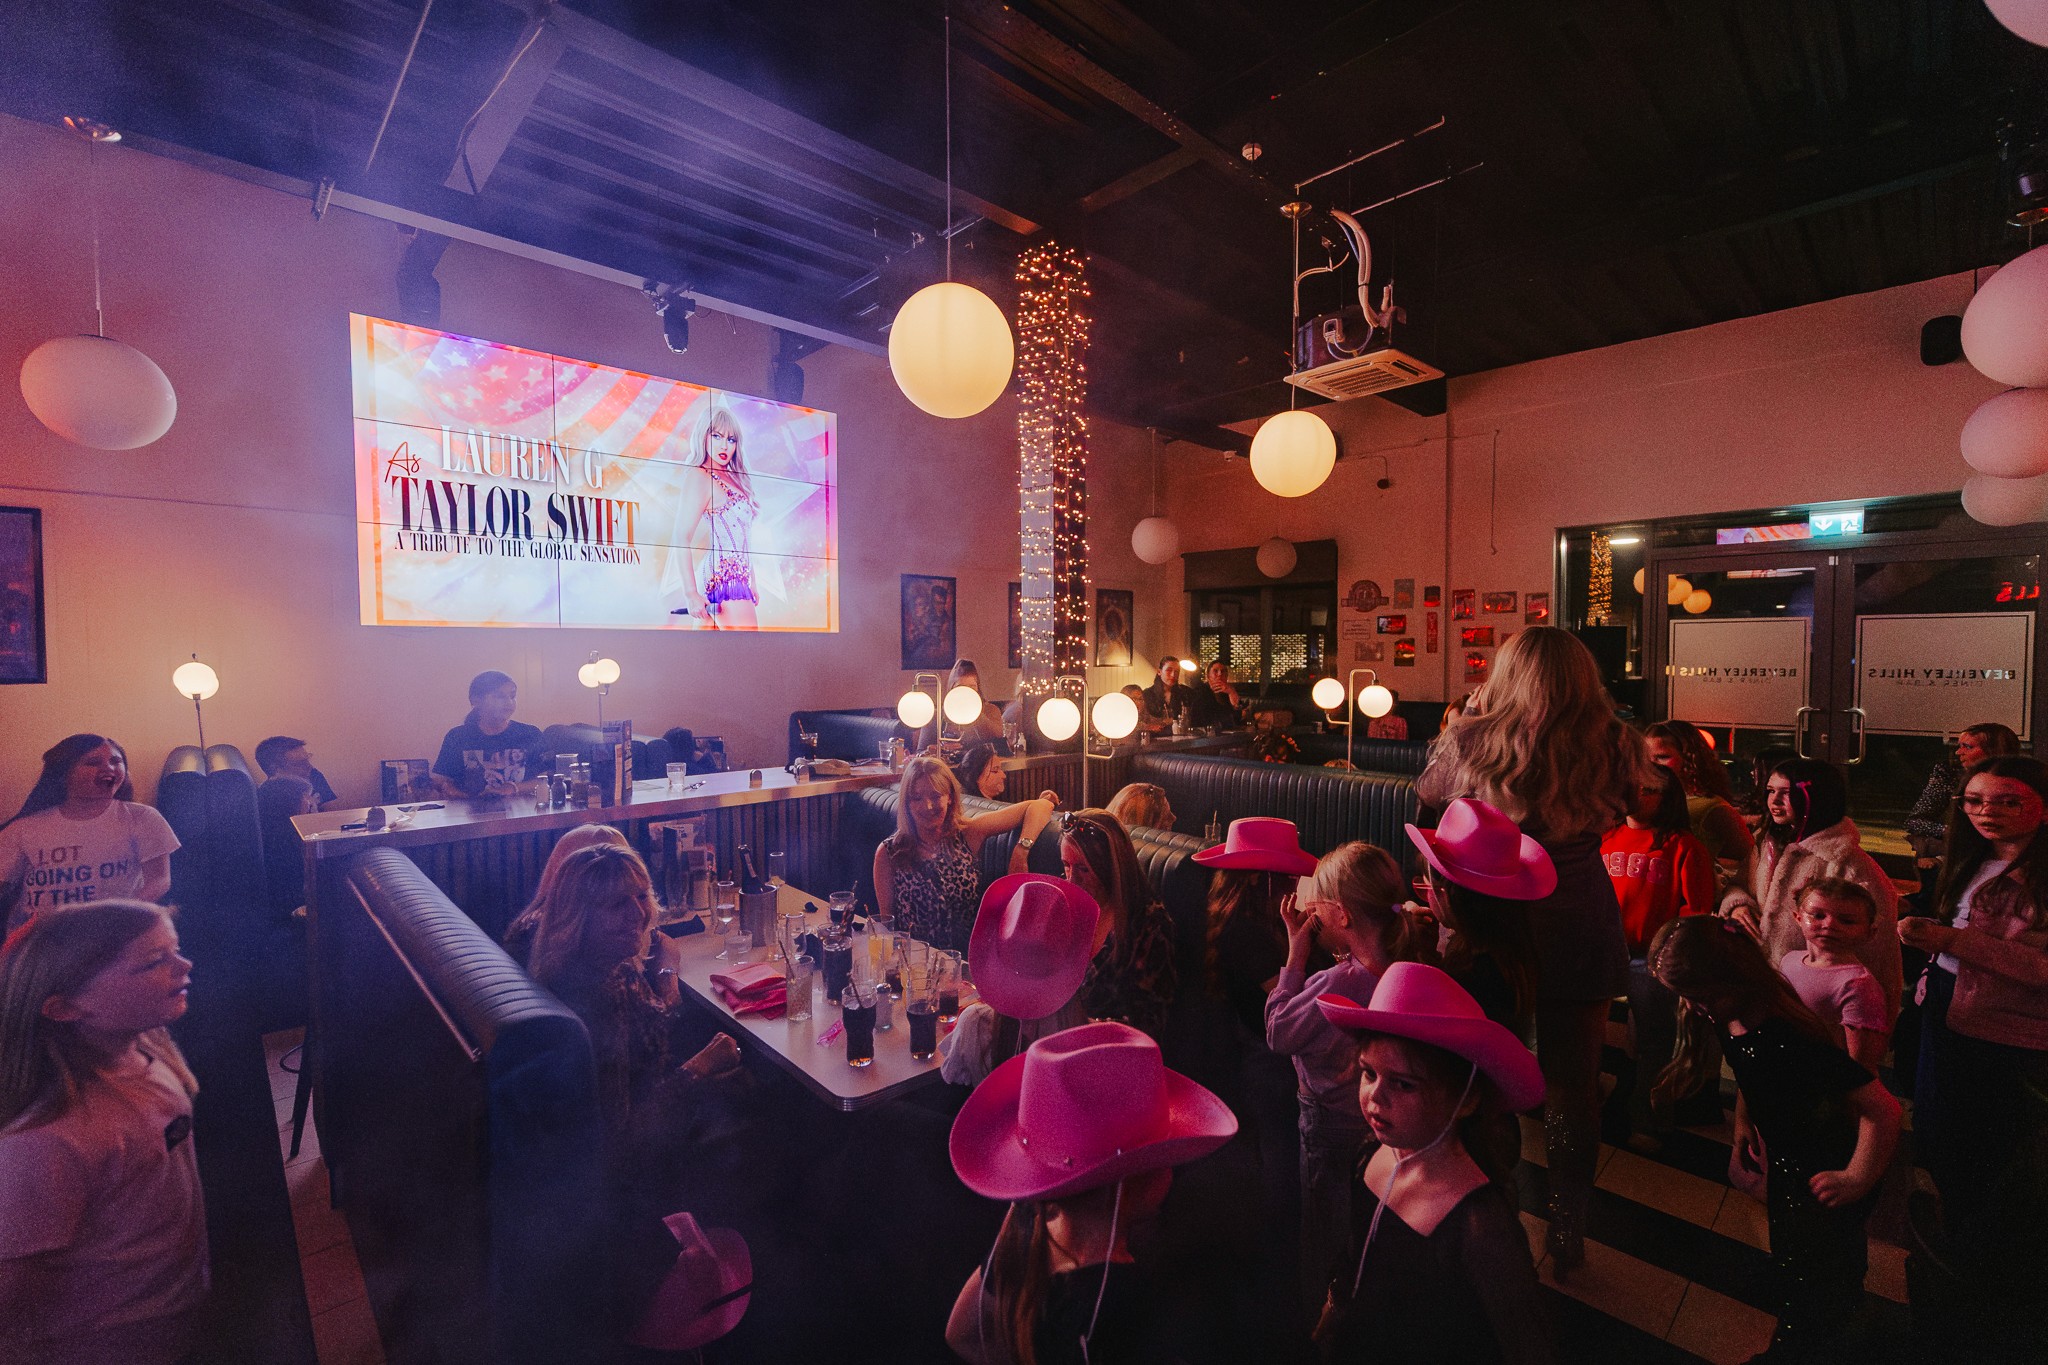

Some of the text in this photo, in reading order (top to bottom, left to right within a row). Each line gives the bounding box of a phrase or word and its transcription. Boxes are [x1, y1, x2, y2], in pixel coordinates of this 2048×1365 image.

[384, 441, 422, 483] As
[441, 424, 603, 490] LAUREN G
[391, 475, 641, 547] TAYLOR SWIFT
[394, 531, 640, 565] A TRIBUTE TO THE GLOBAL SENSATION
[38, 846, 83, 866] LOT
[51, 885, 96, 906] THE
